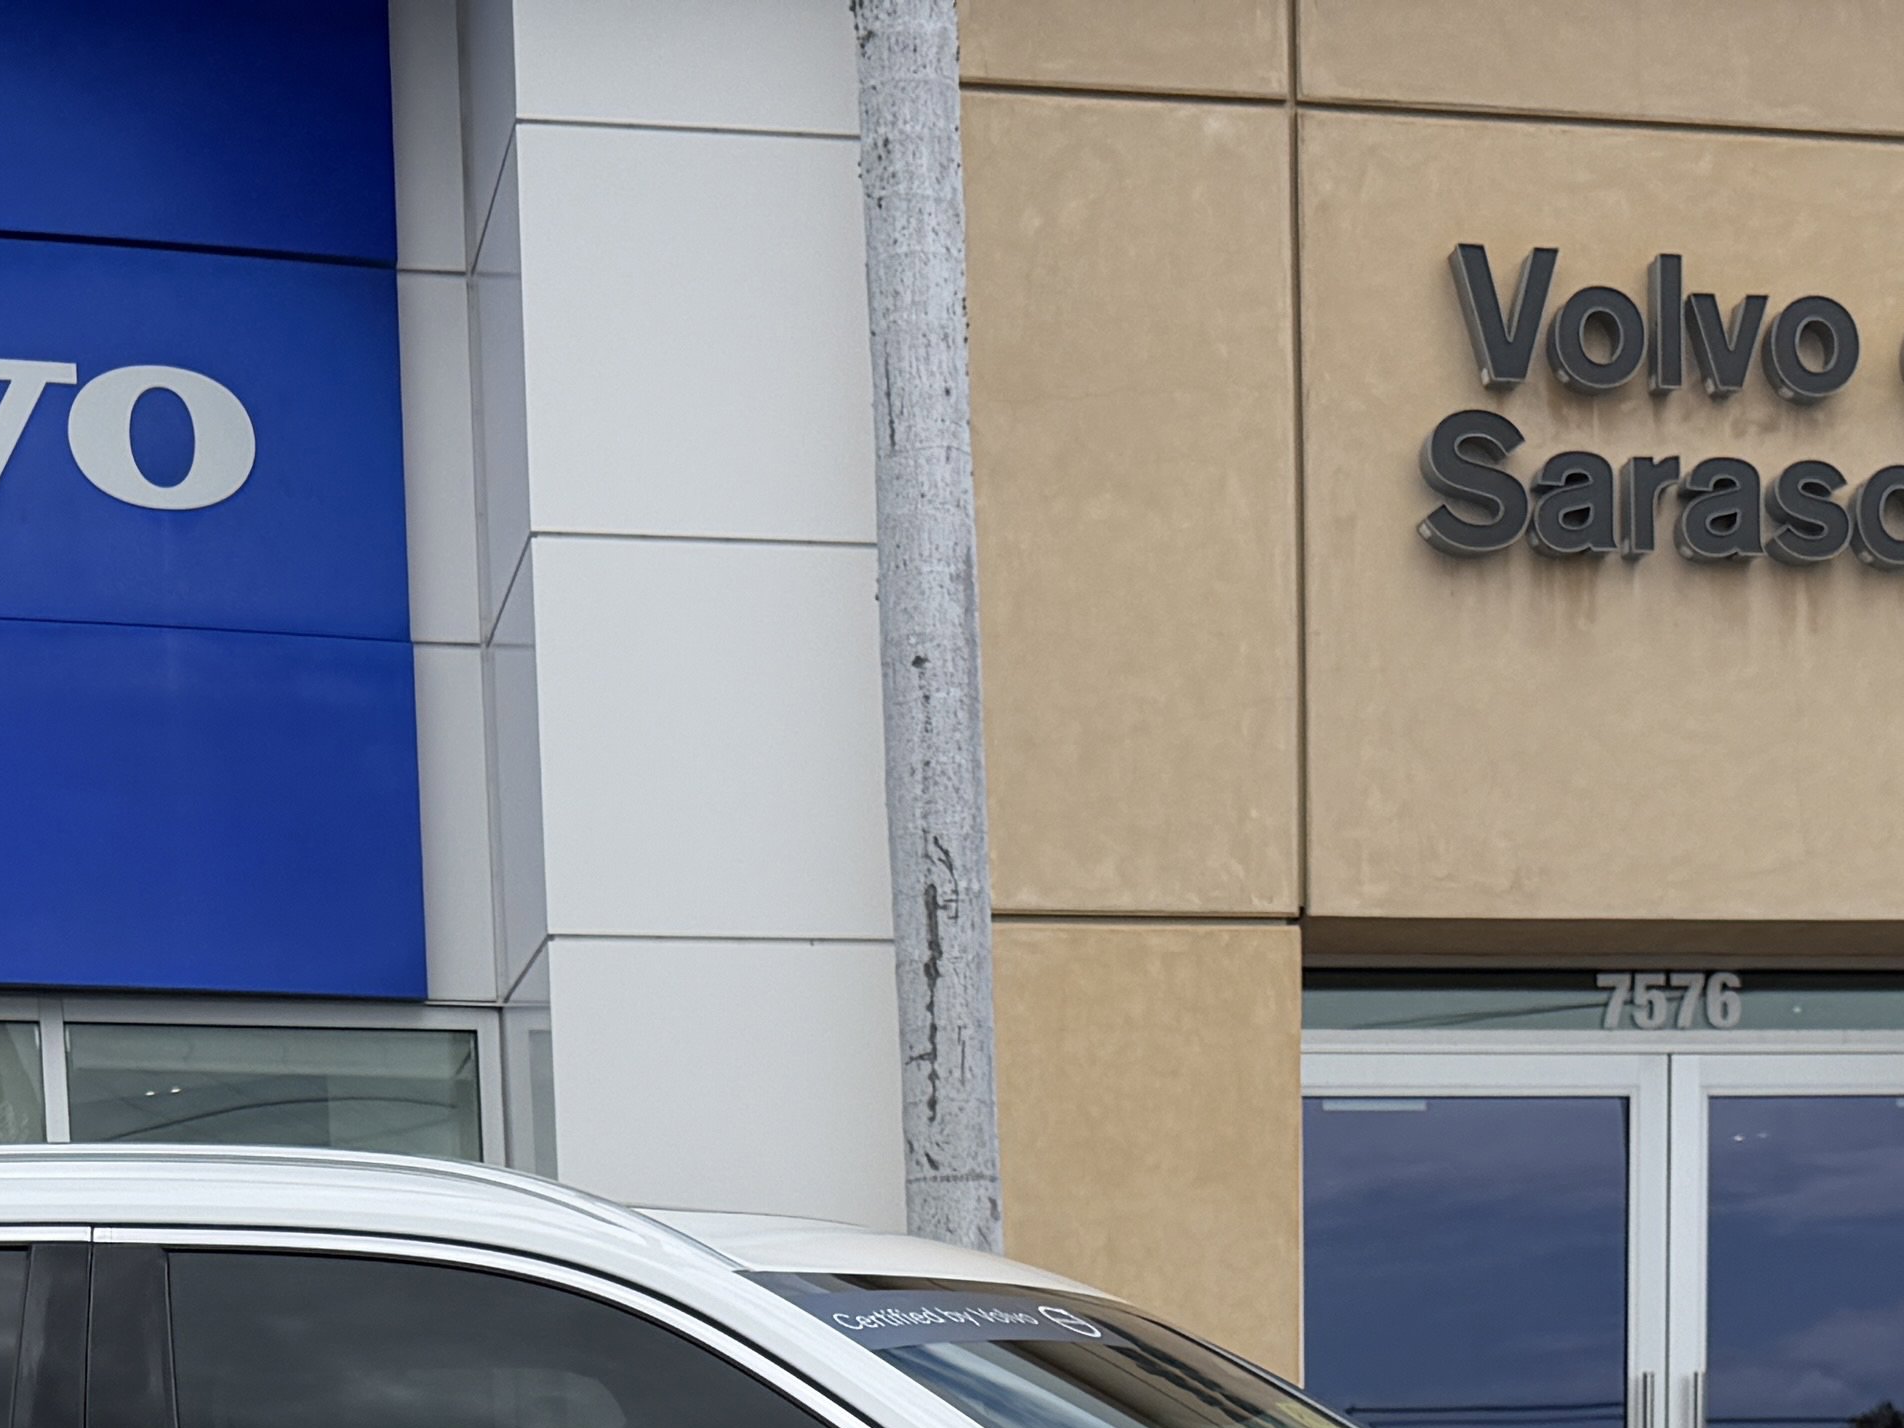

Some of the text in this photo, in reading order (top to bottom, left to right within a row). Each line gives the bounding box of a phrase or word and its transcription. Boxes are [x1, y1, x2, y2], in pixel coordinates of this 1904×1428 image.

[1448, 243, 1860, 397] Volvo
[1596, 971, 1744, 1030] 7576
[832, 1306, 1039, 1330] Certified by Volvo
